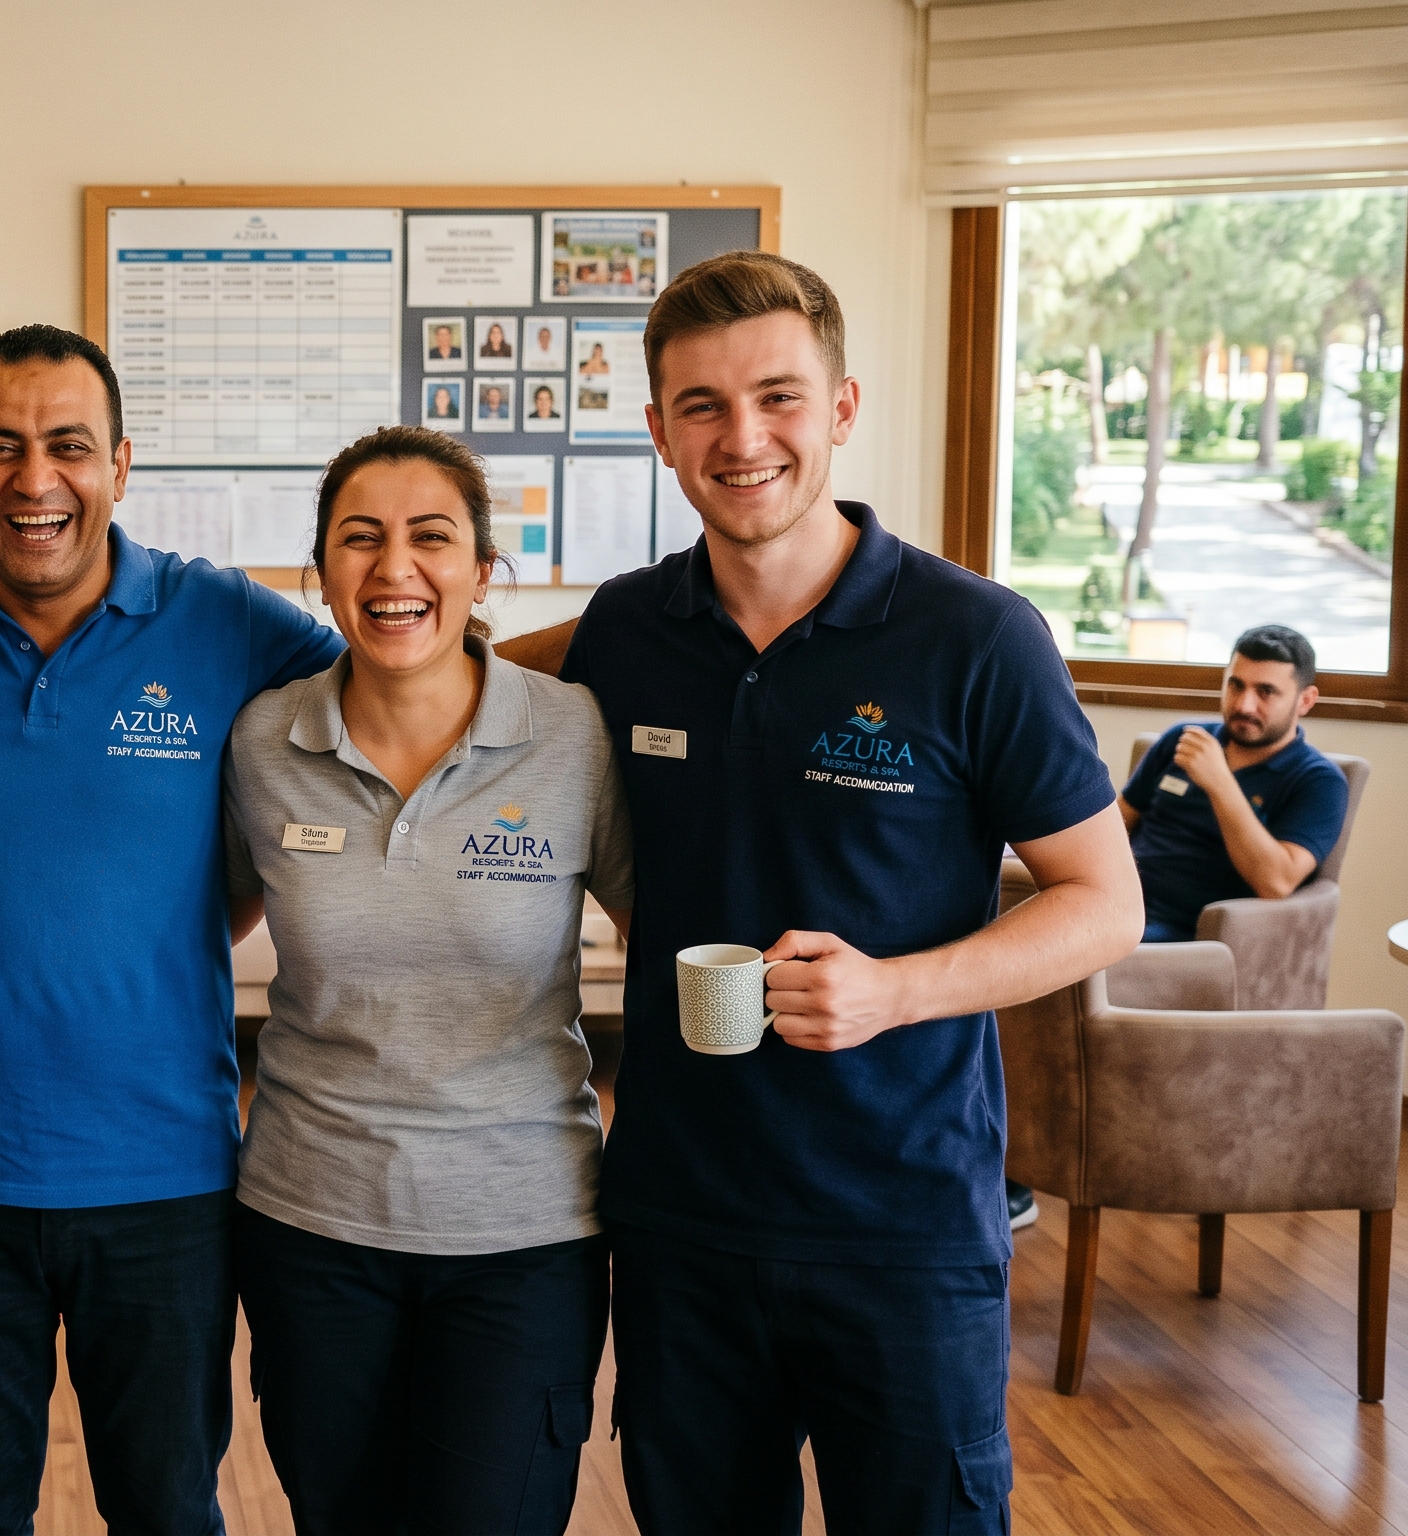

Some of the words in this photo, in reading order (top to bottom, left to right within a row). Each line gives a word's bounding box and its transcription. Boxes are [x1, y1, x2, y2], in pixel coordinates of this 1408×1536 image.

[110, 710, 198, 735] AZURA
[811, 731, 915, 766] AZURA
[804, 769, 833, 783] STAFF
[821, 757, 867, 773] RESORTS
[870, 765, 879, 775] &
[880, 766, 900, 777] SPA
[461, 833, 554, 859] AZURA
[456, 870, 484, 880] STAFF
